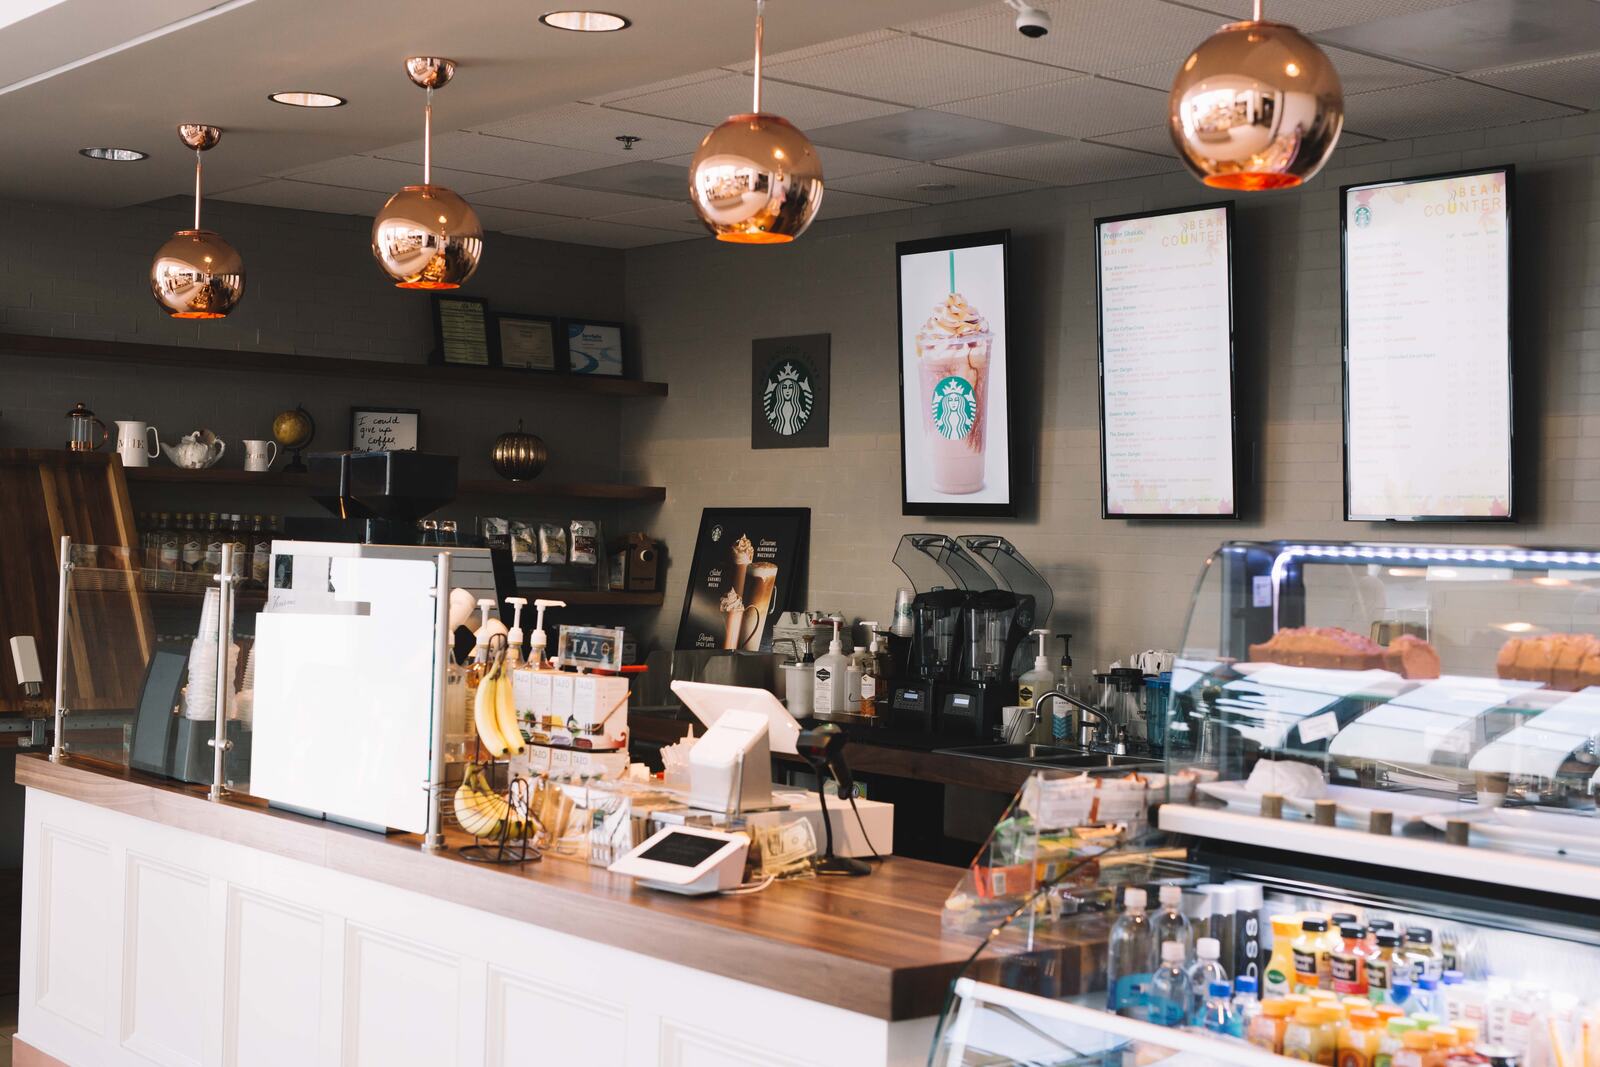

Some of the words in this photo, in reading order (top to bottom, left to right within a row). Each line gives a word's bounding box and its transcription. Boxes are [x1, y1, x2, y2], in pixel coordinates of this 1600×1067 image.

[1460, 184, 1501, 198] BEAN
[1424, 197, 1502, 218] COUNTER
[1190, 217, 1224, 230] BEAN
[1162, 230, 1224, 247] COUNTER
[373, 416, 400, 425] could
[360, 427, 376, 439] give
[379, 427, 392, 436] up
[571, 639, 610, 657] TAZO
[1245, 918, 1258, 977] OSS
